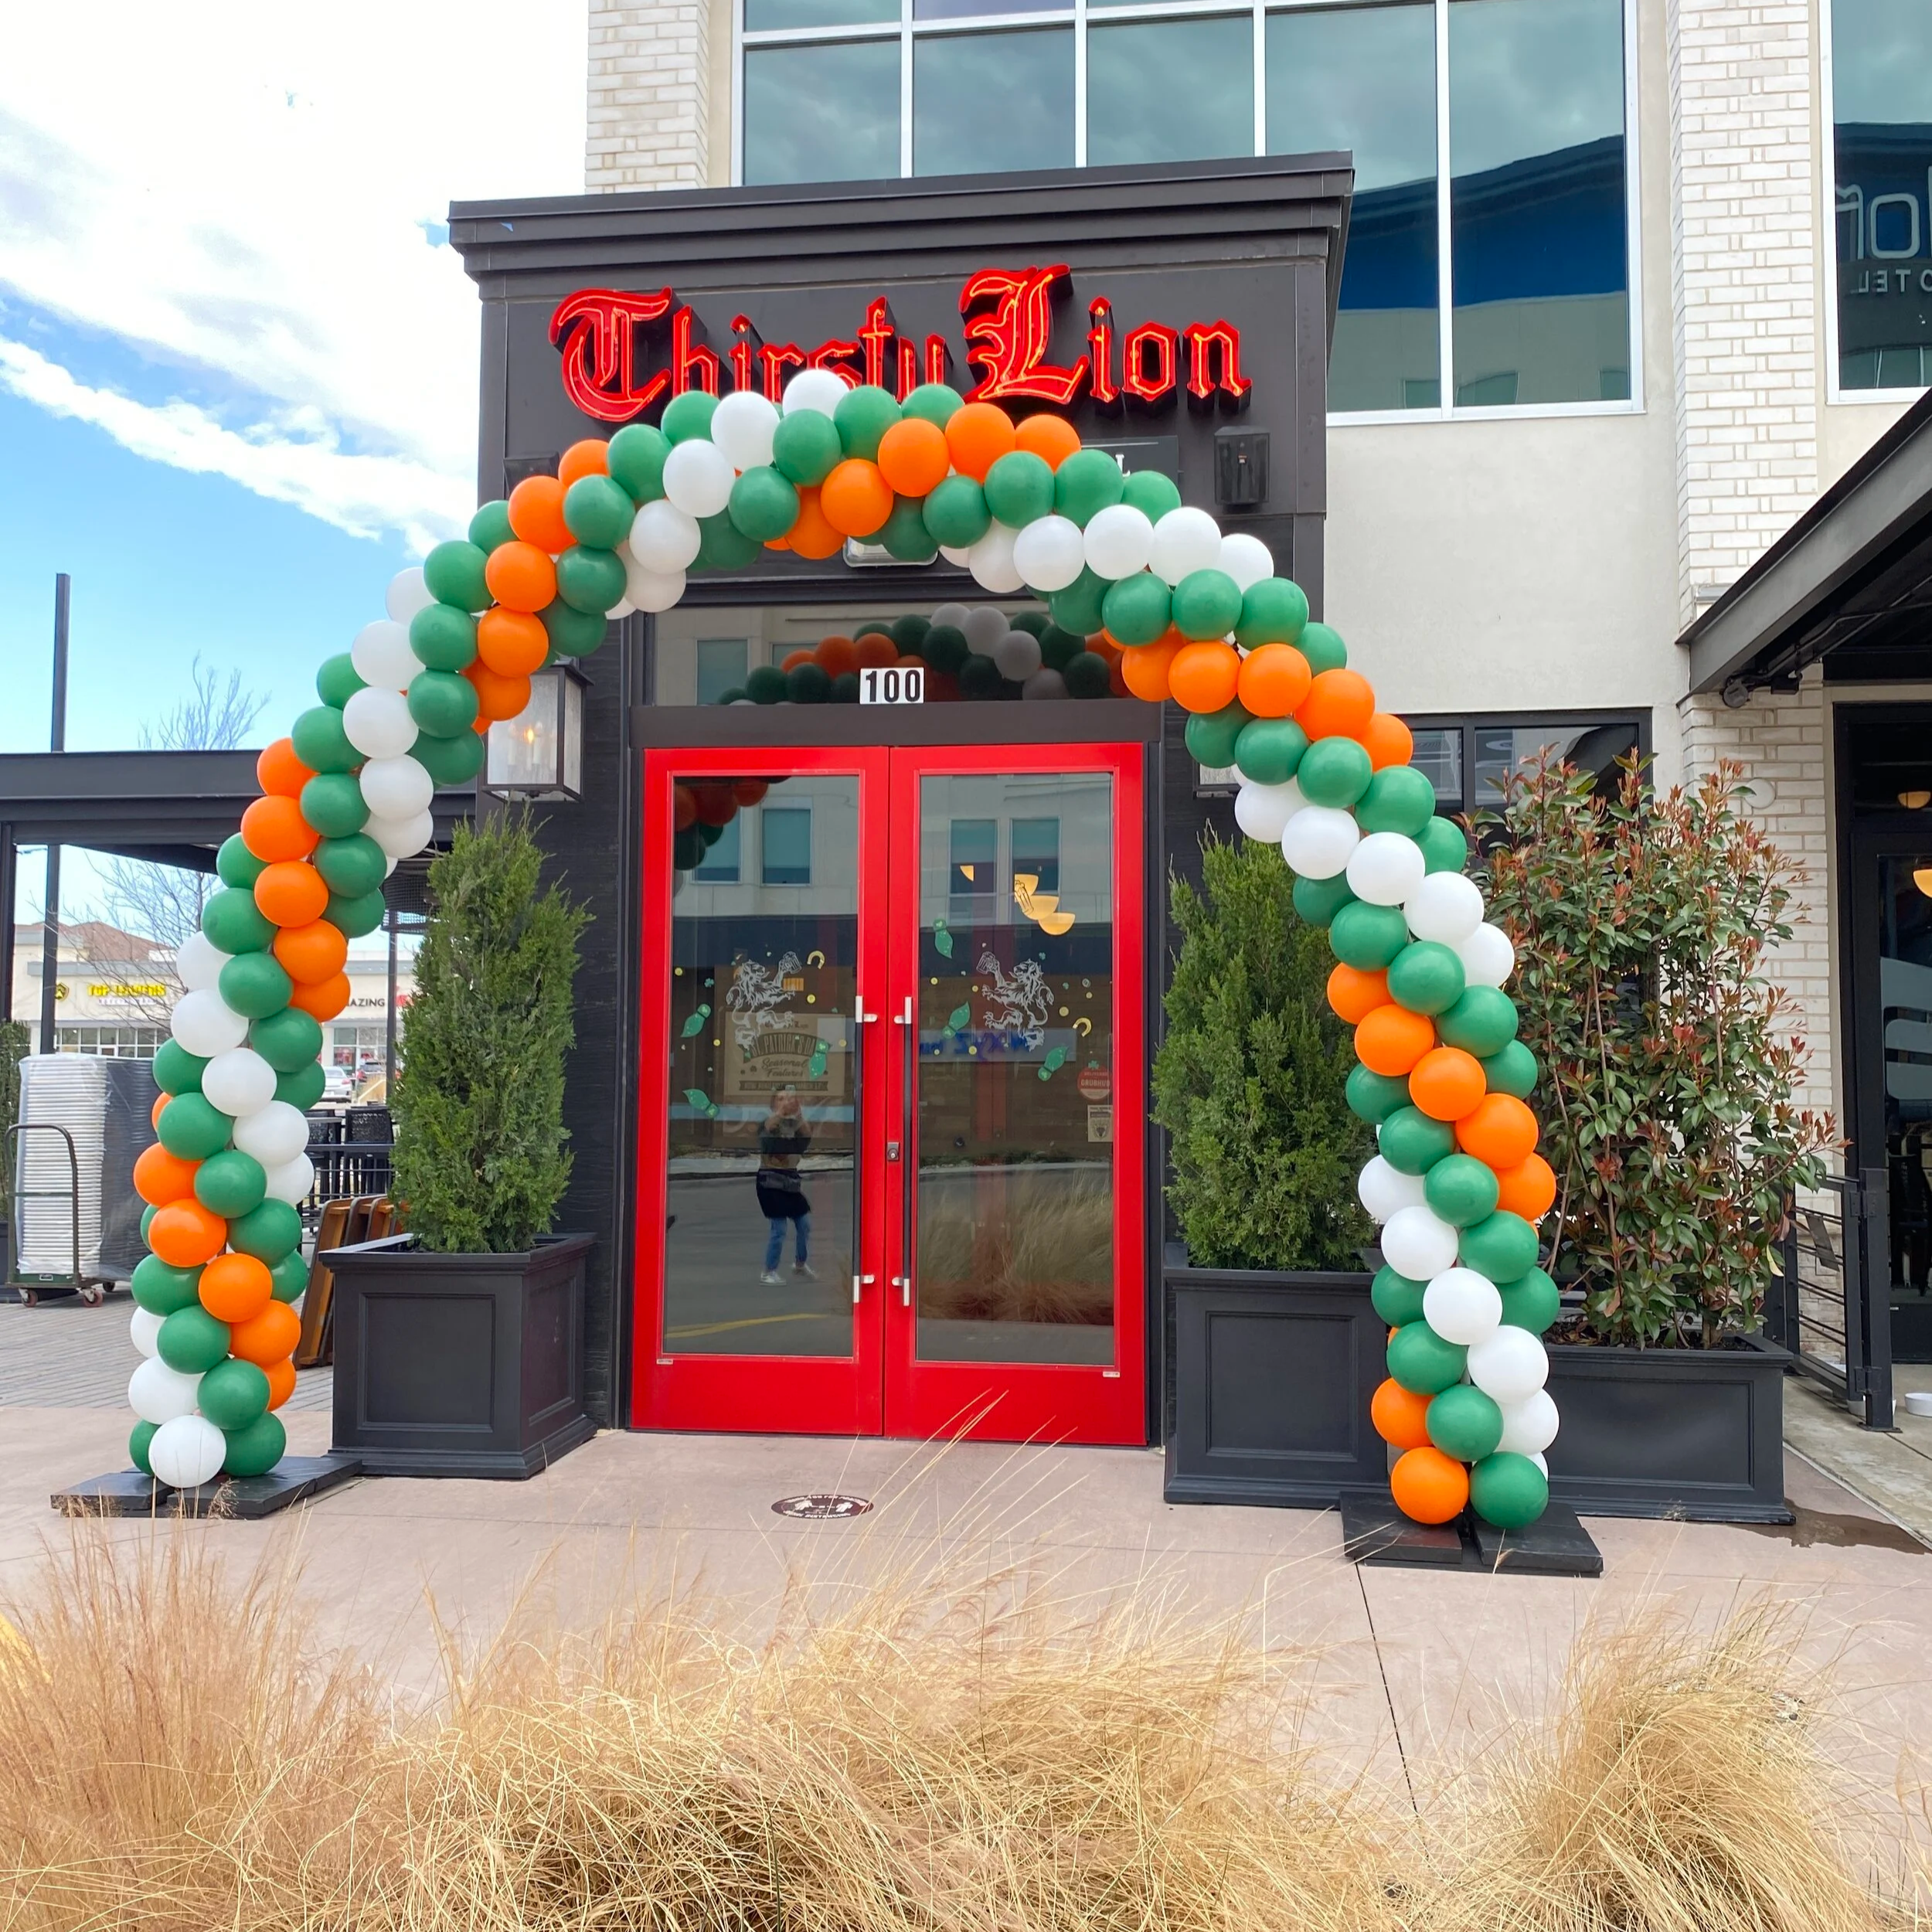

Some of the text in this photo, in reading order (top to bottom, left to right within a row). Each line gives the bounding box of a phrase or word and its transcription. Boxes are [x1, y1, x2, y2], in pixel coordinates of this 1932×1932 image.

[548, 264, 1253, 422] Thirsty Lion
[866, 669, 920, 702] 100
[347, 998, 386, 1007] AZING
[764, 1032, 804, 1053] PATRICKS
[1081, 1079, 1111, 1087] GRUBHUB
